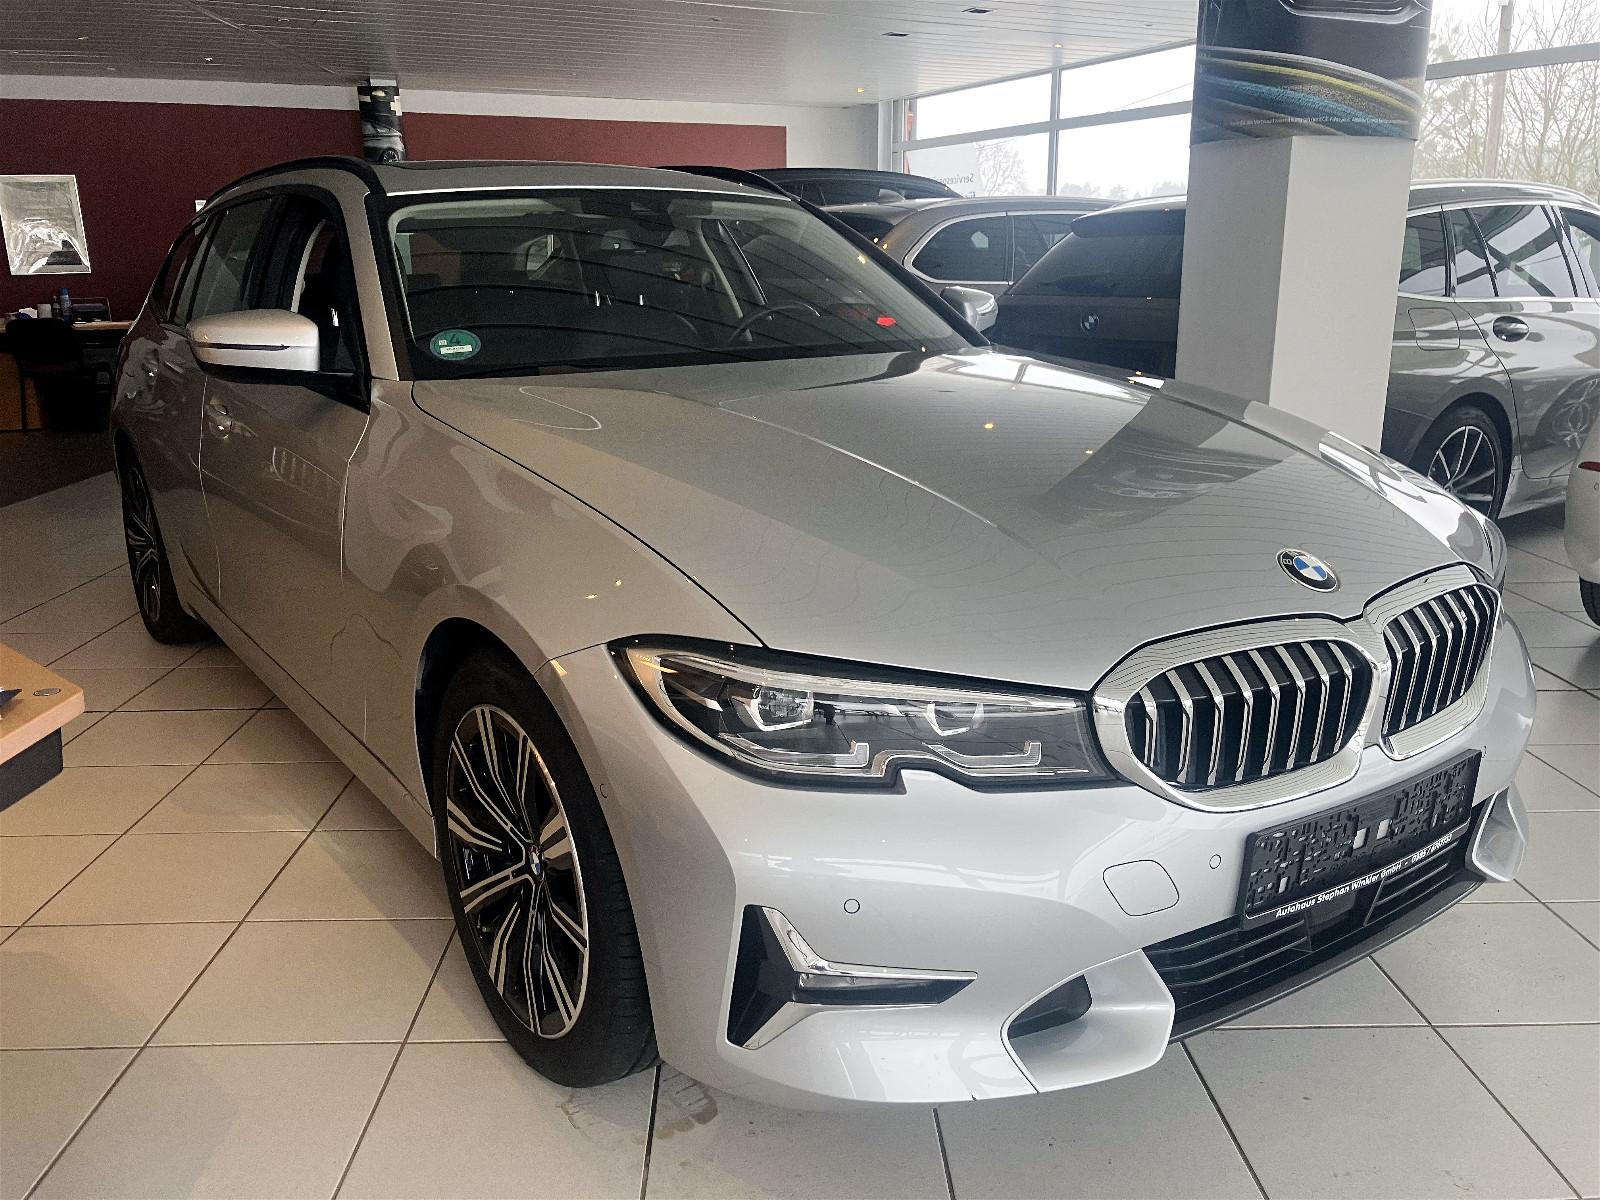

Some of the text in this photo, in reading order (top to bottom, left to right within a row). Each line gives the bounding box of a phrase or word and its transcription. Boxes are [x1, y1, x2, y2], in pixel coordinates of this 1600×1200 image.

[1275, 899, 1316, 919] Autohaus
[1316, 885, 1350, 904] Stephan
[1351, 874, 1380, 891] Winkler
[1380, 862, 1402, 878] GmbH
